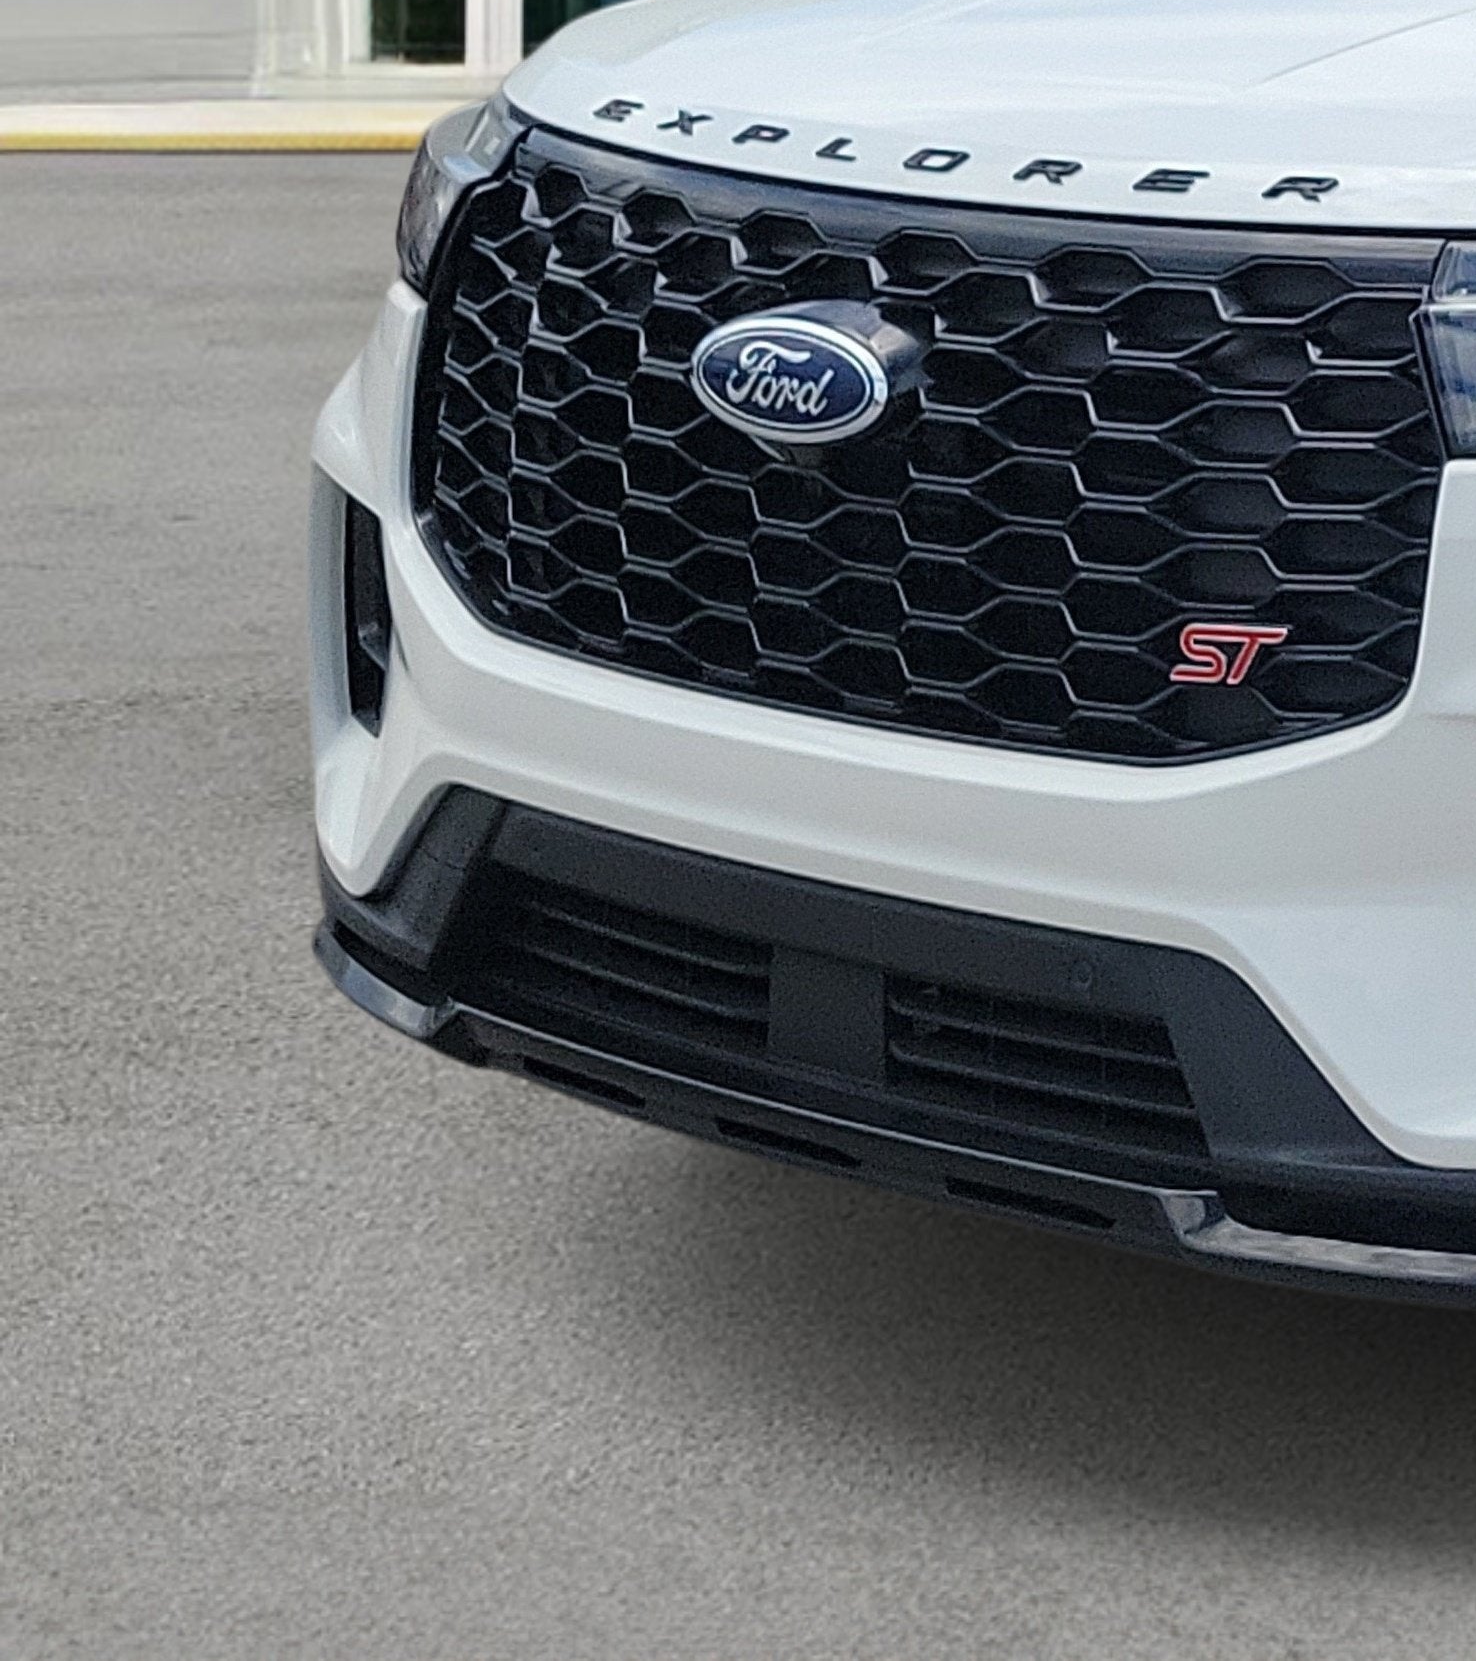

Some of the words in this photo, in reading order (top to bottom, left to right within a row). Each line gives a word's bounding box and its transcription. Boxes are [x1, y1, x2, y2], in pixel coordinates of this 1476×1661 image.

[593, 98, 1340, 203] EXPLORER
[726, 340, 836, 416] Ford
[1169, 623, 1288, 685] ST
